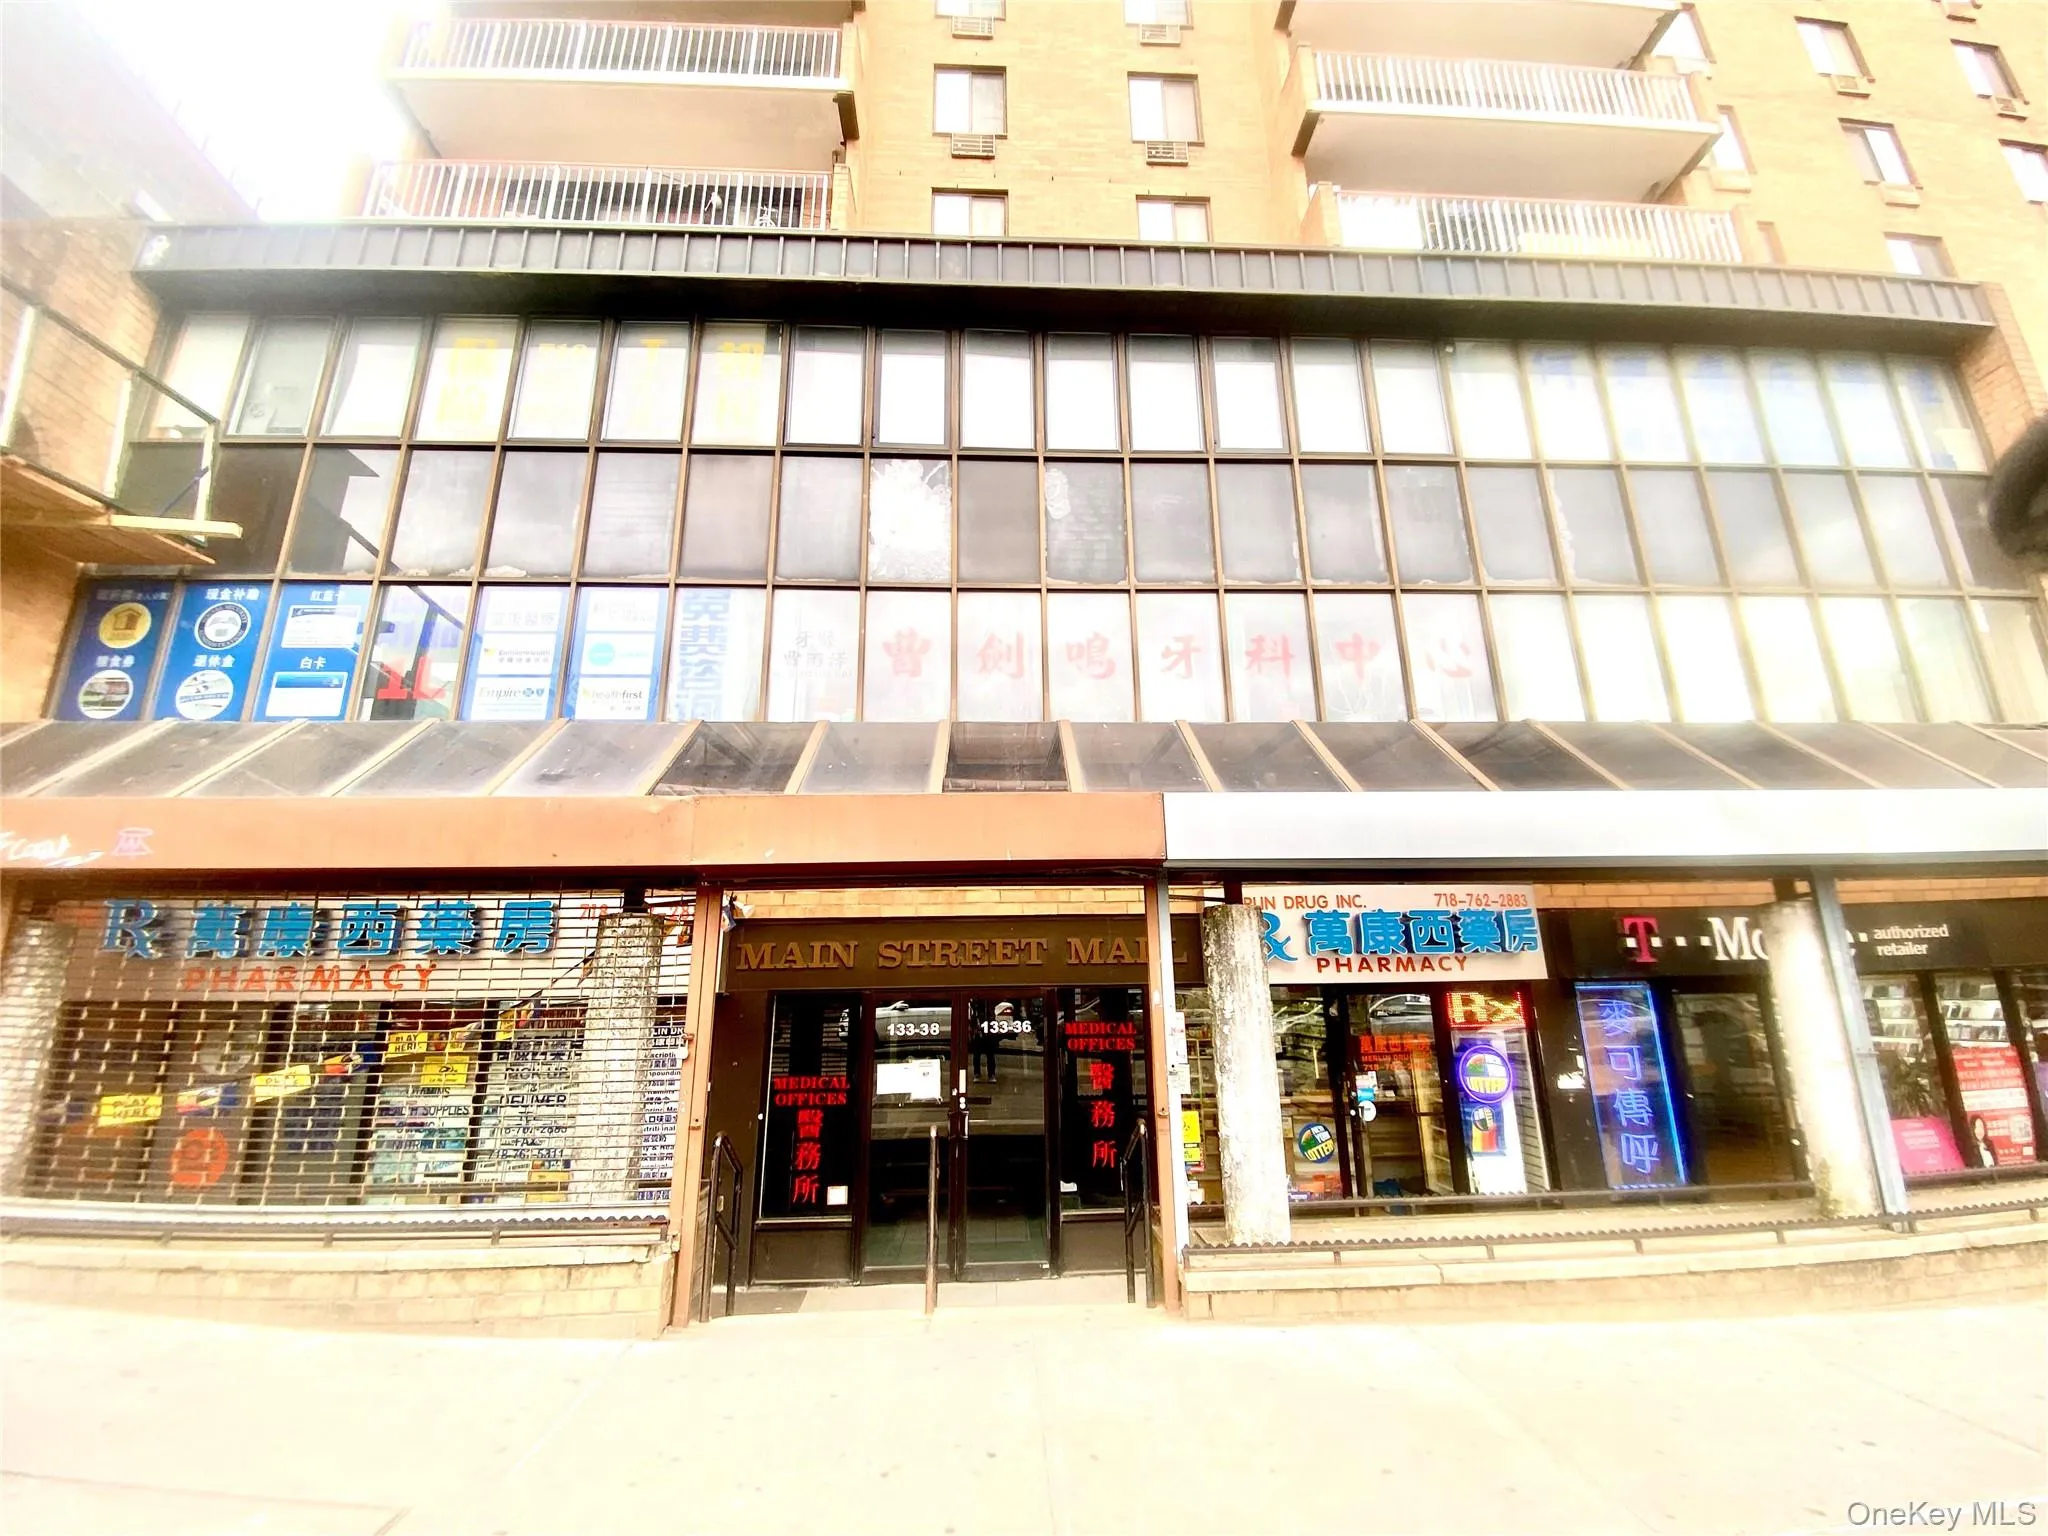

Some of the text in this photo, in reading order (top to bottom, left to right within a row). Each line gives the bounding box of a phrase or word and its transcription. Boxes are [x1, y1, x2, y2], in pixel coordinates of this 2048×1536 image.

[300, 656, 326, 670] 白卡
[1284, 894, 1329, 909] DRUG
[1336, 894, 1367, 909] INC.
[1434, 893, 1528, 907] 718-762-2883
[1304, 907, 1540, 955] 萬康西藥房
[1874, 924, 1949, 940] authorized
[736, 940, 859, 970] MAIN
[877, 937, 1048, 969] STREET
[1877, 942, 1929, 957] retailer
[1317, 955, 1468, 973] PHARMACY
[185, 962, 438, 992] PHARMACY
[887, 1023, 940, 1037] 133-38
[981, 1020, 1032, 1034] 133-36
[1065, 1022, 1137, 1035] MEDICAL
[1066, 1038, 1135, 1051] OFFICES
[774, 1076, 851, 1090] MEDICAL
[775, 1092, 848, 1106] OFFICES
[422, 1106, 469, 1117] SUPPLIES
[1089, 1063, 1118, 1169] 醫務所
[793, 1108, 824, 1205] 醫務所
